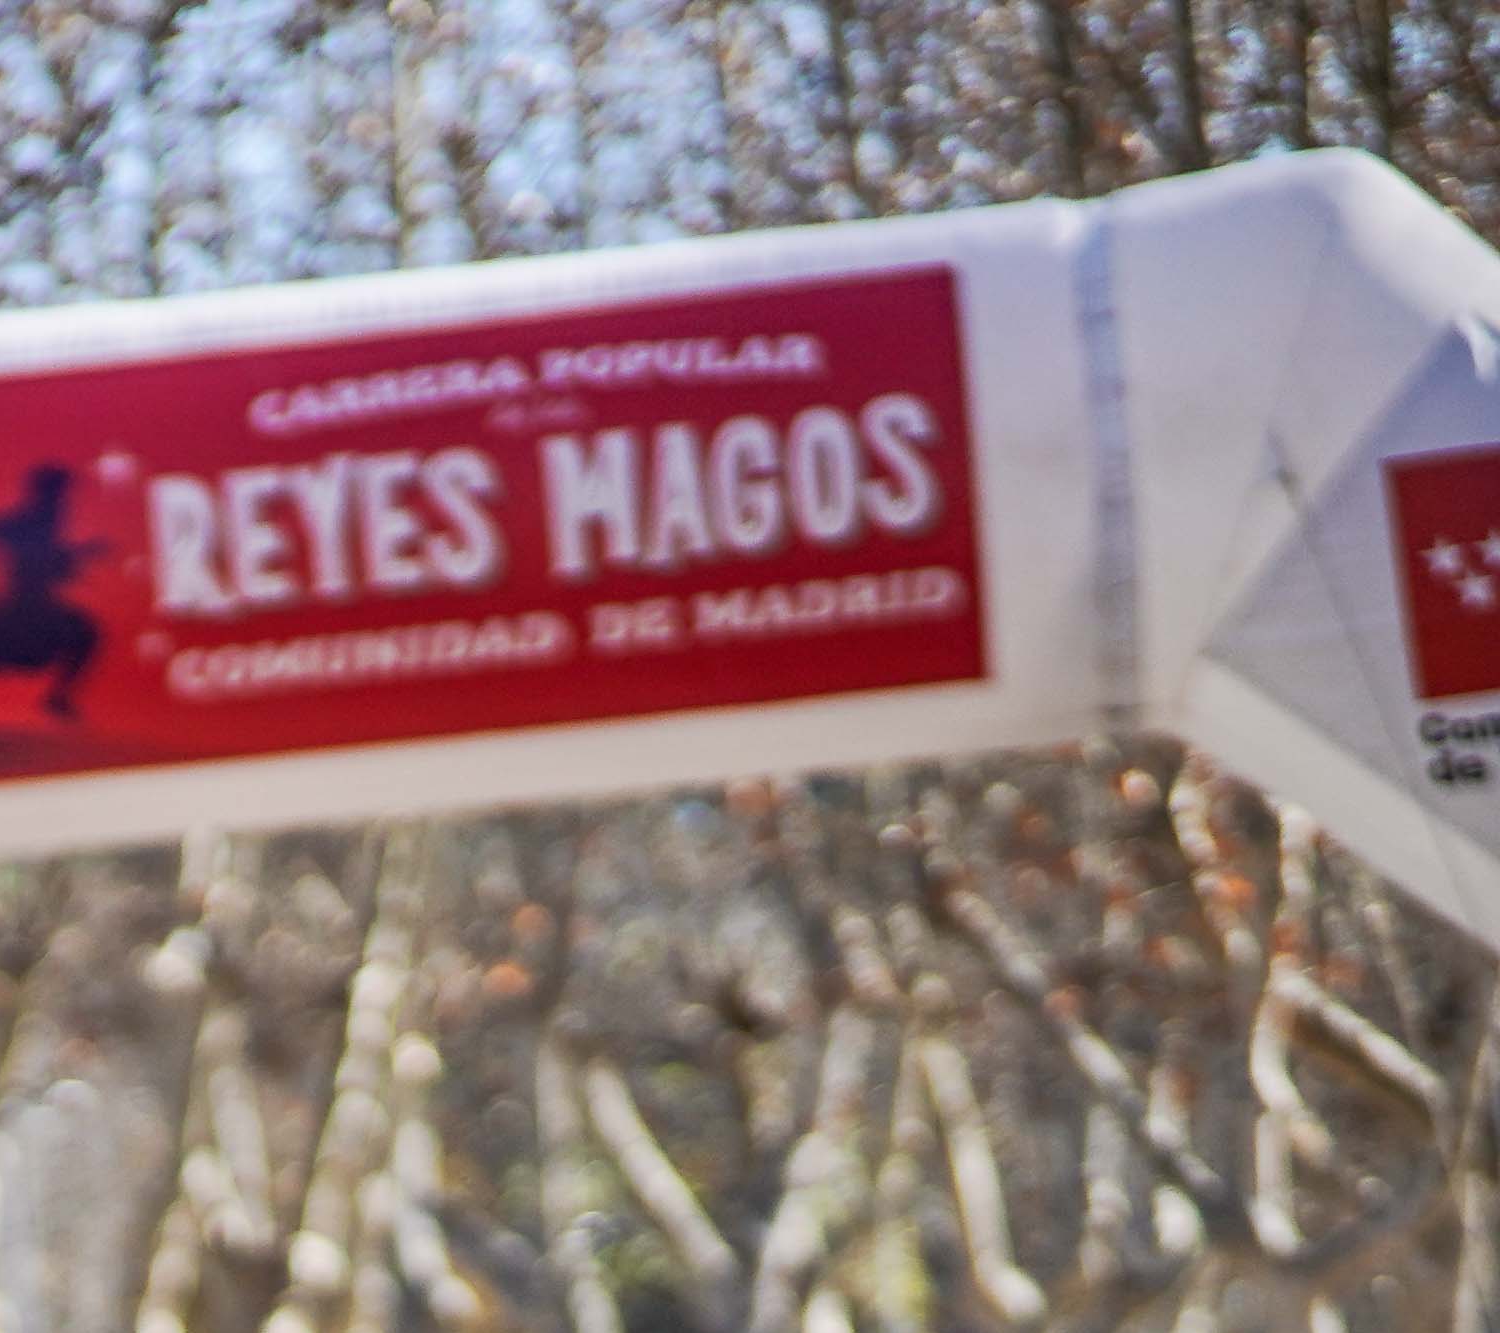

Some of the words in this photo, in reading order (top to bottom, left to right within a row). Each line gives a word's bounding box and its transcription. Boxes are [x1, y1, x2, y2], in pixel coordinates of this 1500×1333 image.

[250, 357, 528, 434] CARRERA
[537, 333, 824, 386] POPULAR
[150, 448, 503, 620] REYES
[540, 392, 940, 580] MAGOS
[170, 612, 564, 700] COMUNIDAD
[590, 598, 678, 652] DE
[694, 567, 963, 638] MADRID
